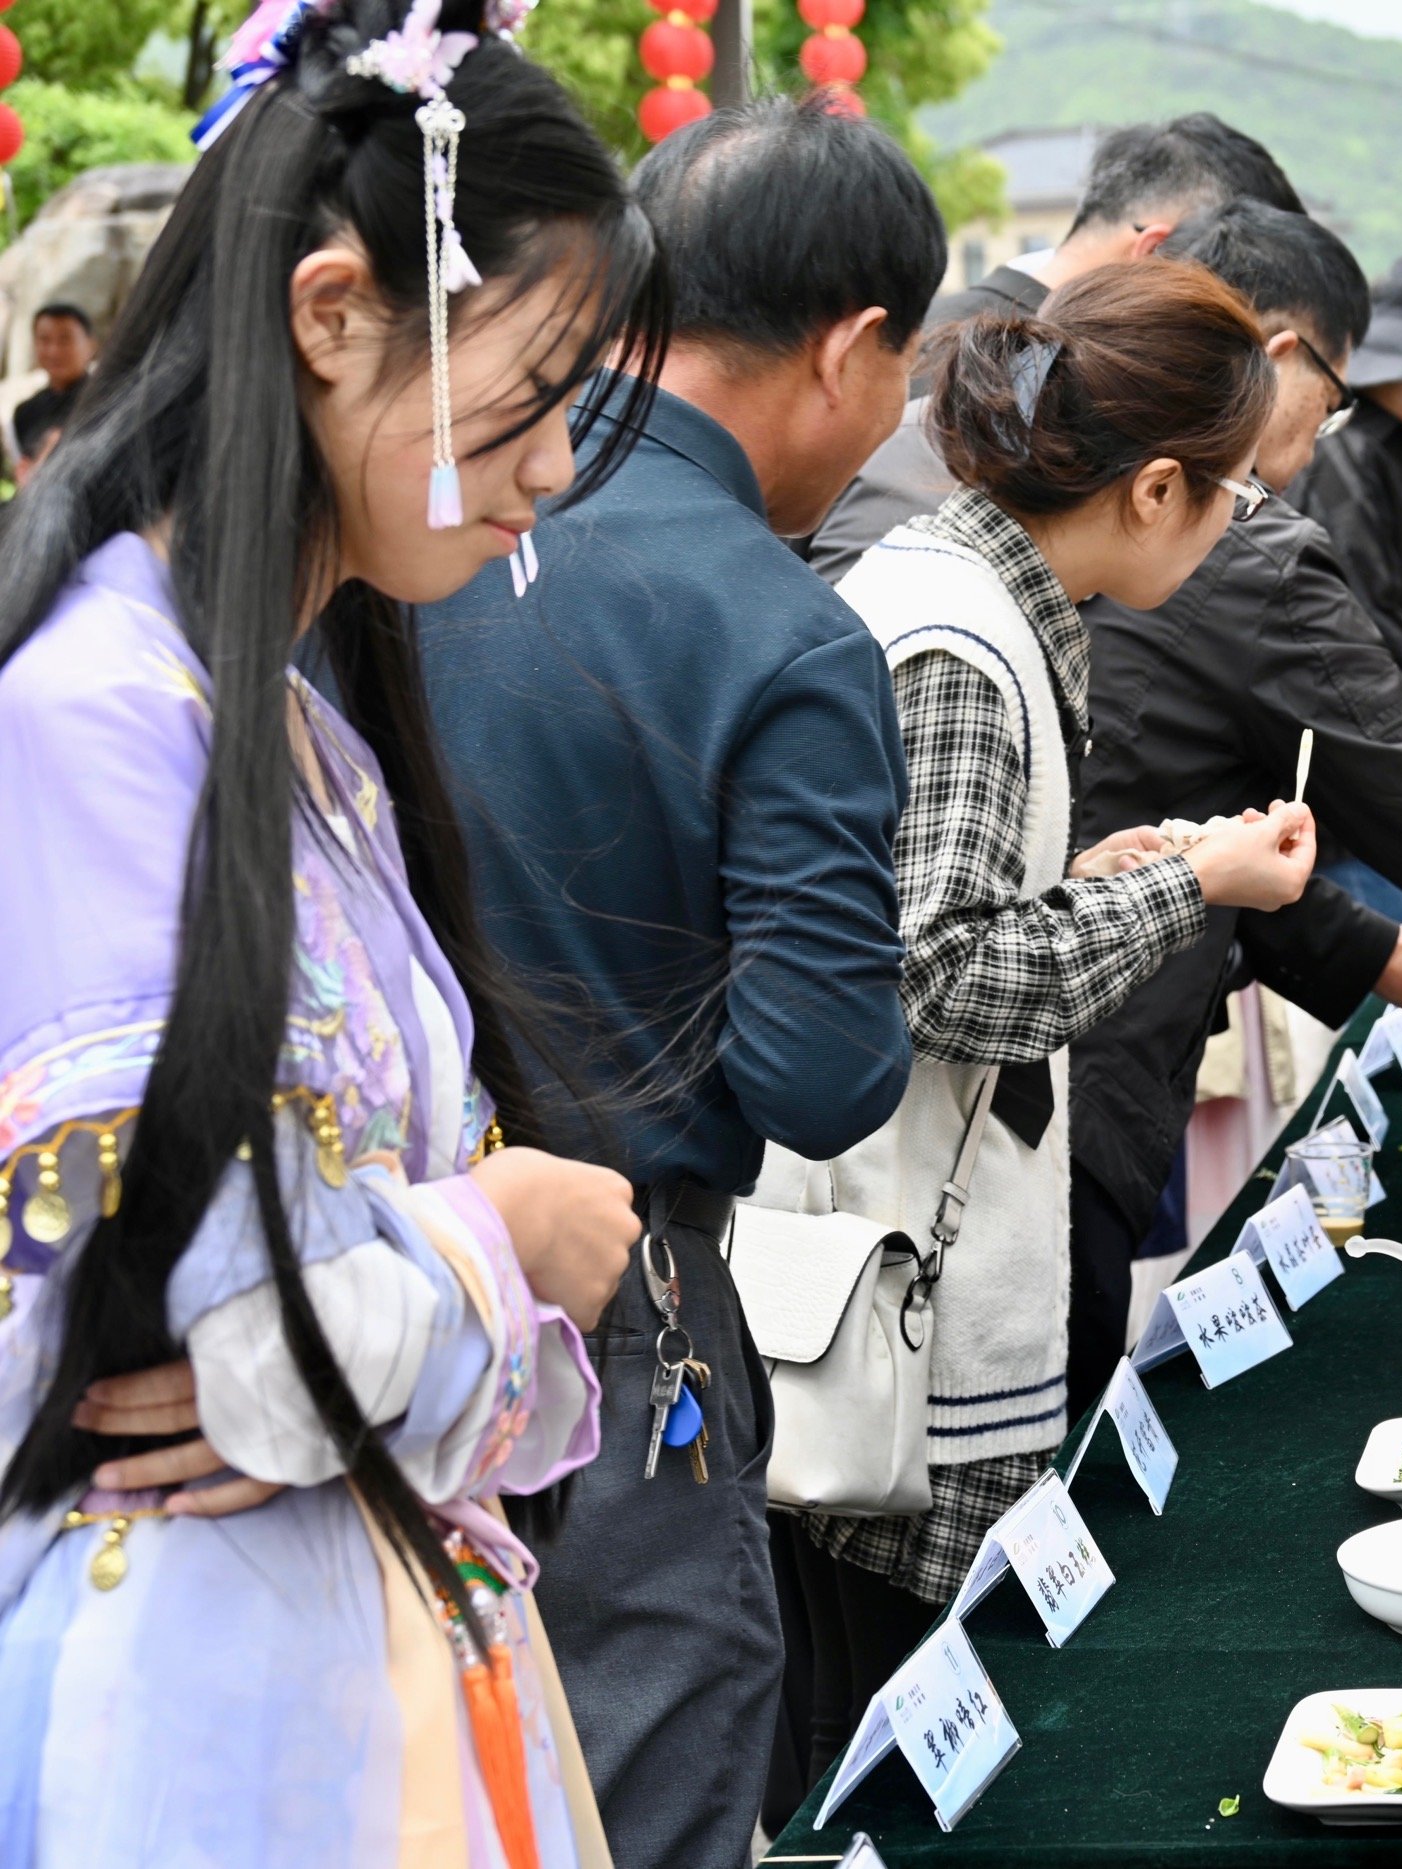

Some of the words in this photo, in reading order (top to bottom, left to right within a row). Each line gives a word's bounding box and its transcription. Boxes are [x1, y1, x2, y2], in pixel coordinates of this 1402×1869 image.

[1231, 1267, 1244, 1285] 8
[1052, 1503, 1067, 1527] 10
[944, 1645, 959, 1671] 11
